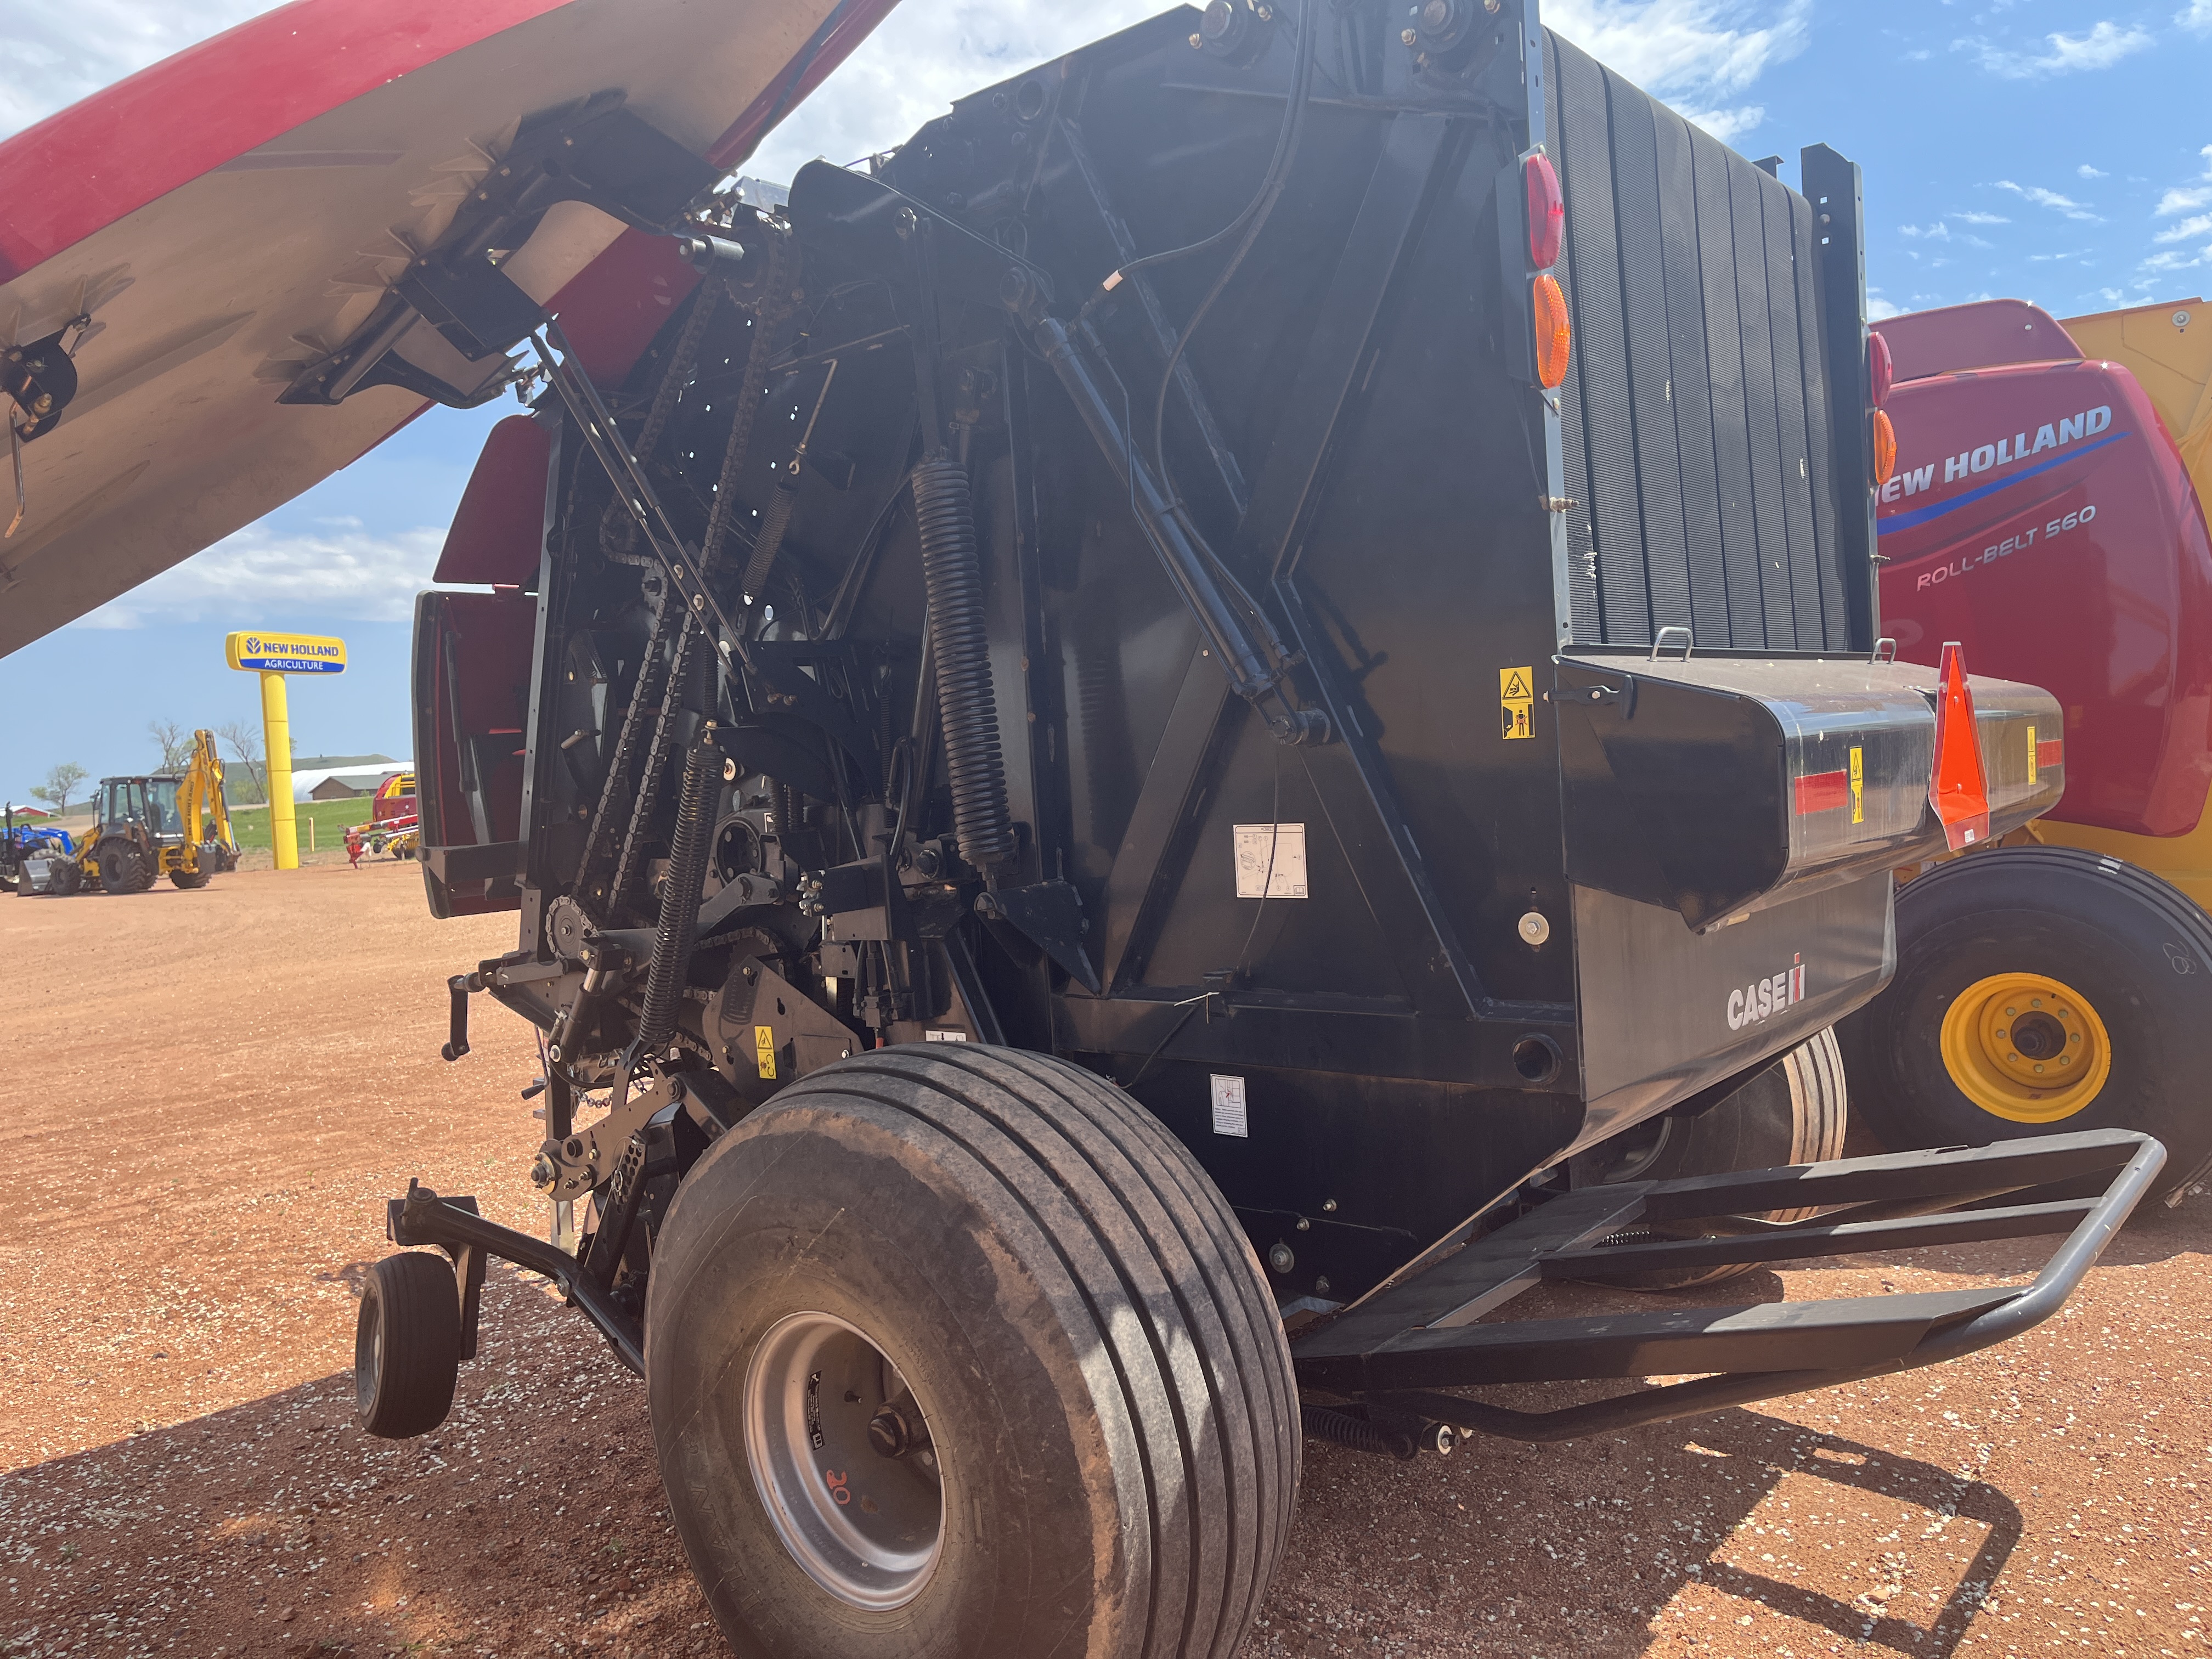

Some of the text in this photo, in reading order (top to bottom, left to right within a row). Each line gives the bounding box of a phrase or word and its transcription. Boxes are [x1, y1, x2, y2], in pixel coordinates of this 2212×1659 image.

[1875, 405, 2112, 506] EW HOLLAND
[1917, 505, 2097, 591] ROLL-BELT 560
[263, 642, 339, 657] NEW HOLLAND
[264, 659, 324, 670] AGRICULTURE
